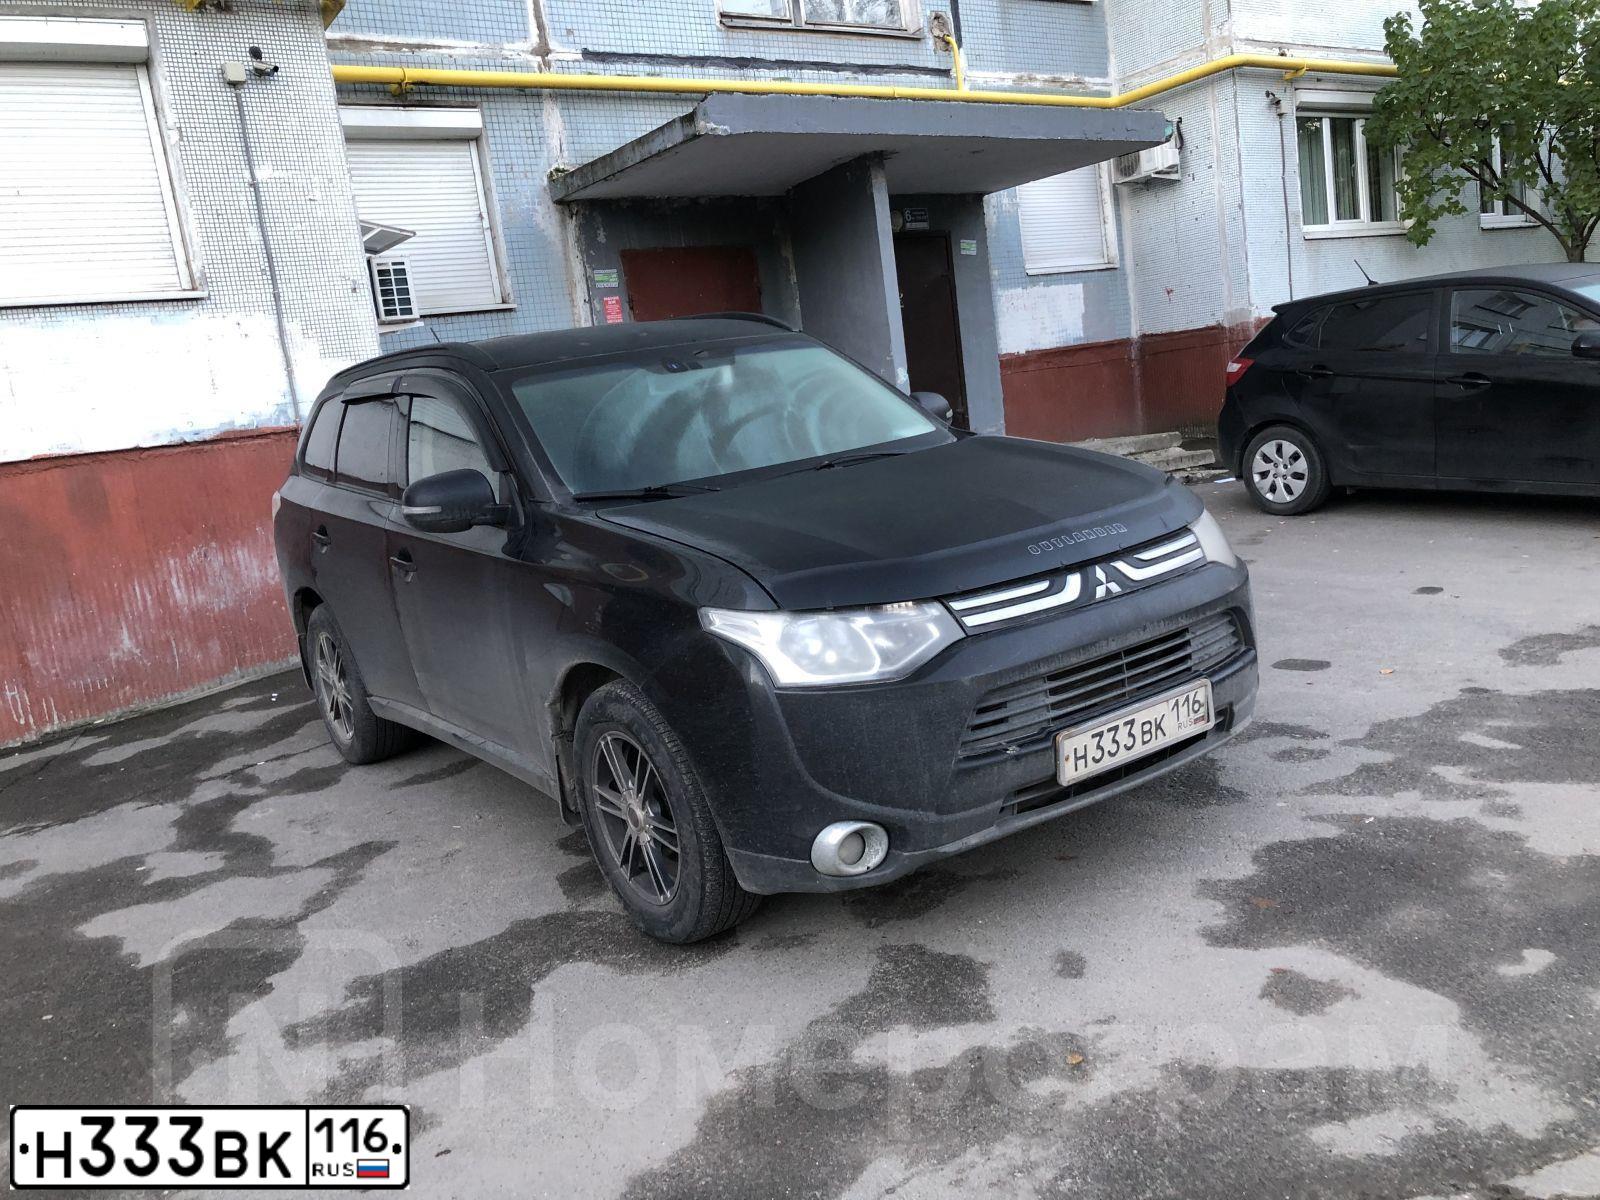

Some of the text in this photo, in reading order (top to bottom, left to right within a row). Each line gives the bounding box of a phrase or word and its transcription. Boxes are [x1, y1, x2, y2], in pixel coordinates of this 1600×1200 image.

[905, 209, 912, 222] 6
[1027, 522, 1128, 555] OUTLANDER
[1170, 691, 1202, 722] 116
[1177, 717, 1193, 732] RUS
